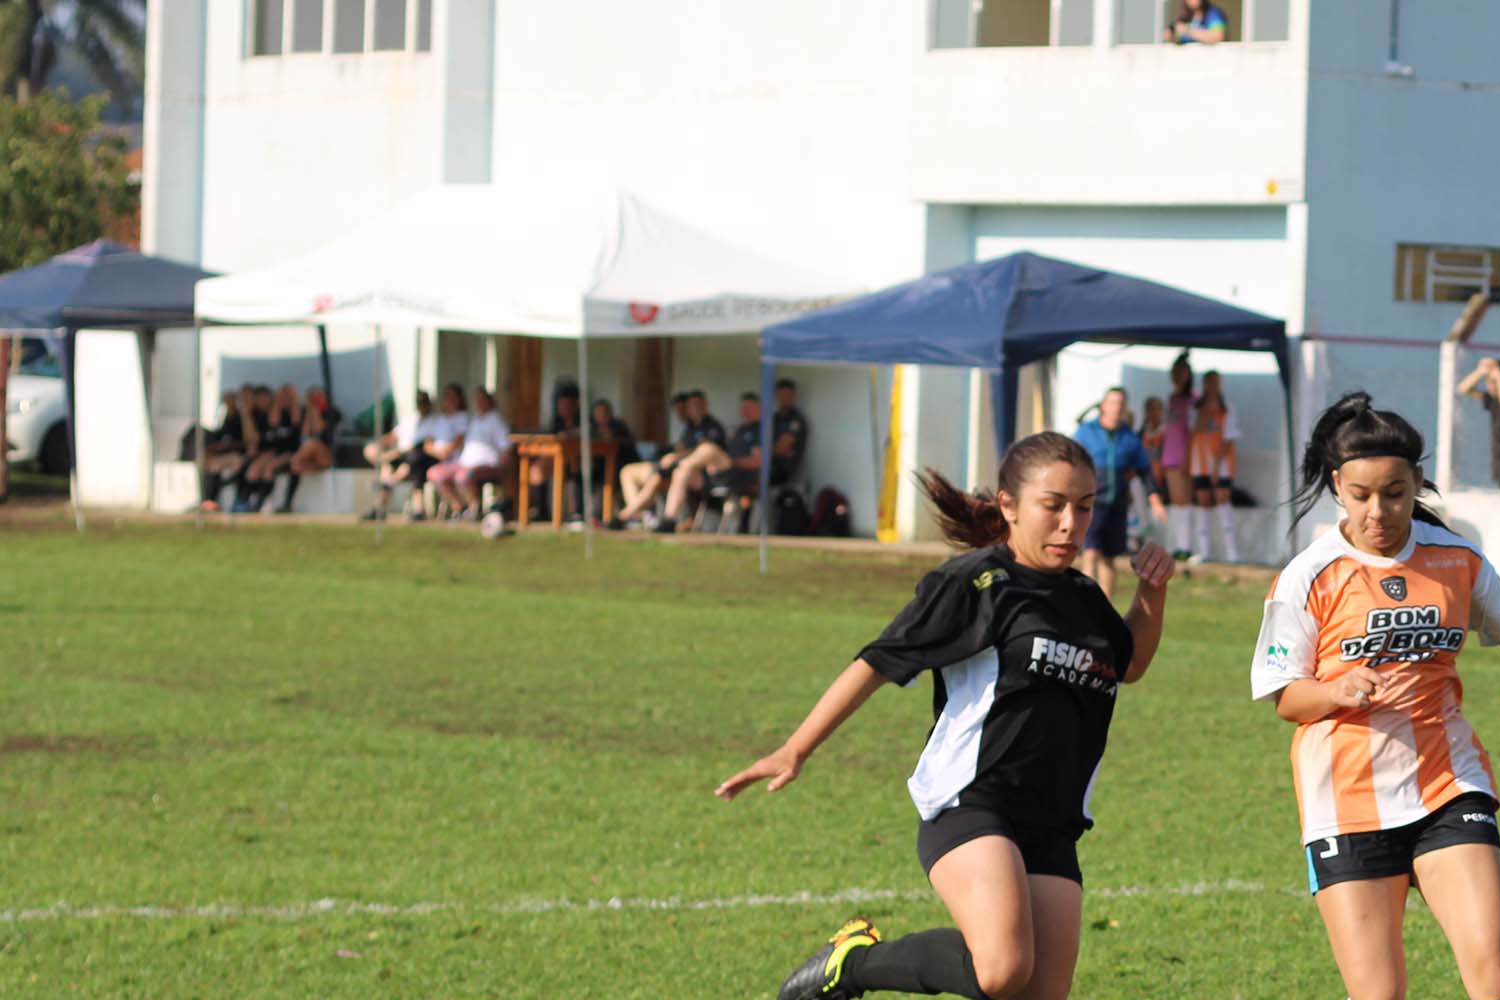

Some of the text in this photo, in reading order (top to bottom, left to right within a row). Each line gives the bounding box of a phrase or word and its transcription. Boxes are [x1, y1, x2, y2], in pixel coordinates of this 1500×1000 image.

[1367, 606, 1439, 633] BOM
[1340, 633, 1388, 660] DE
[1388, 629, 1464, 653] BOLA
